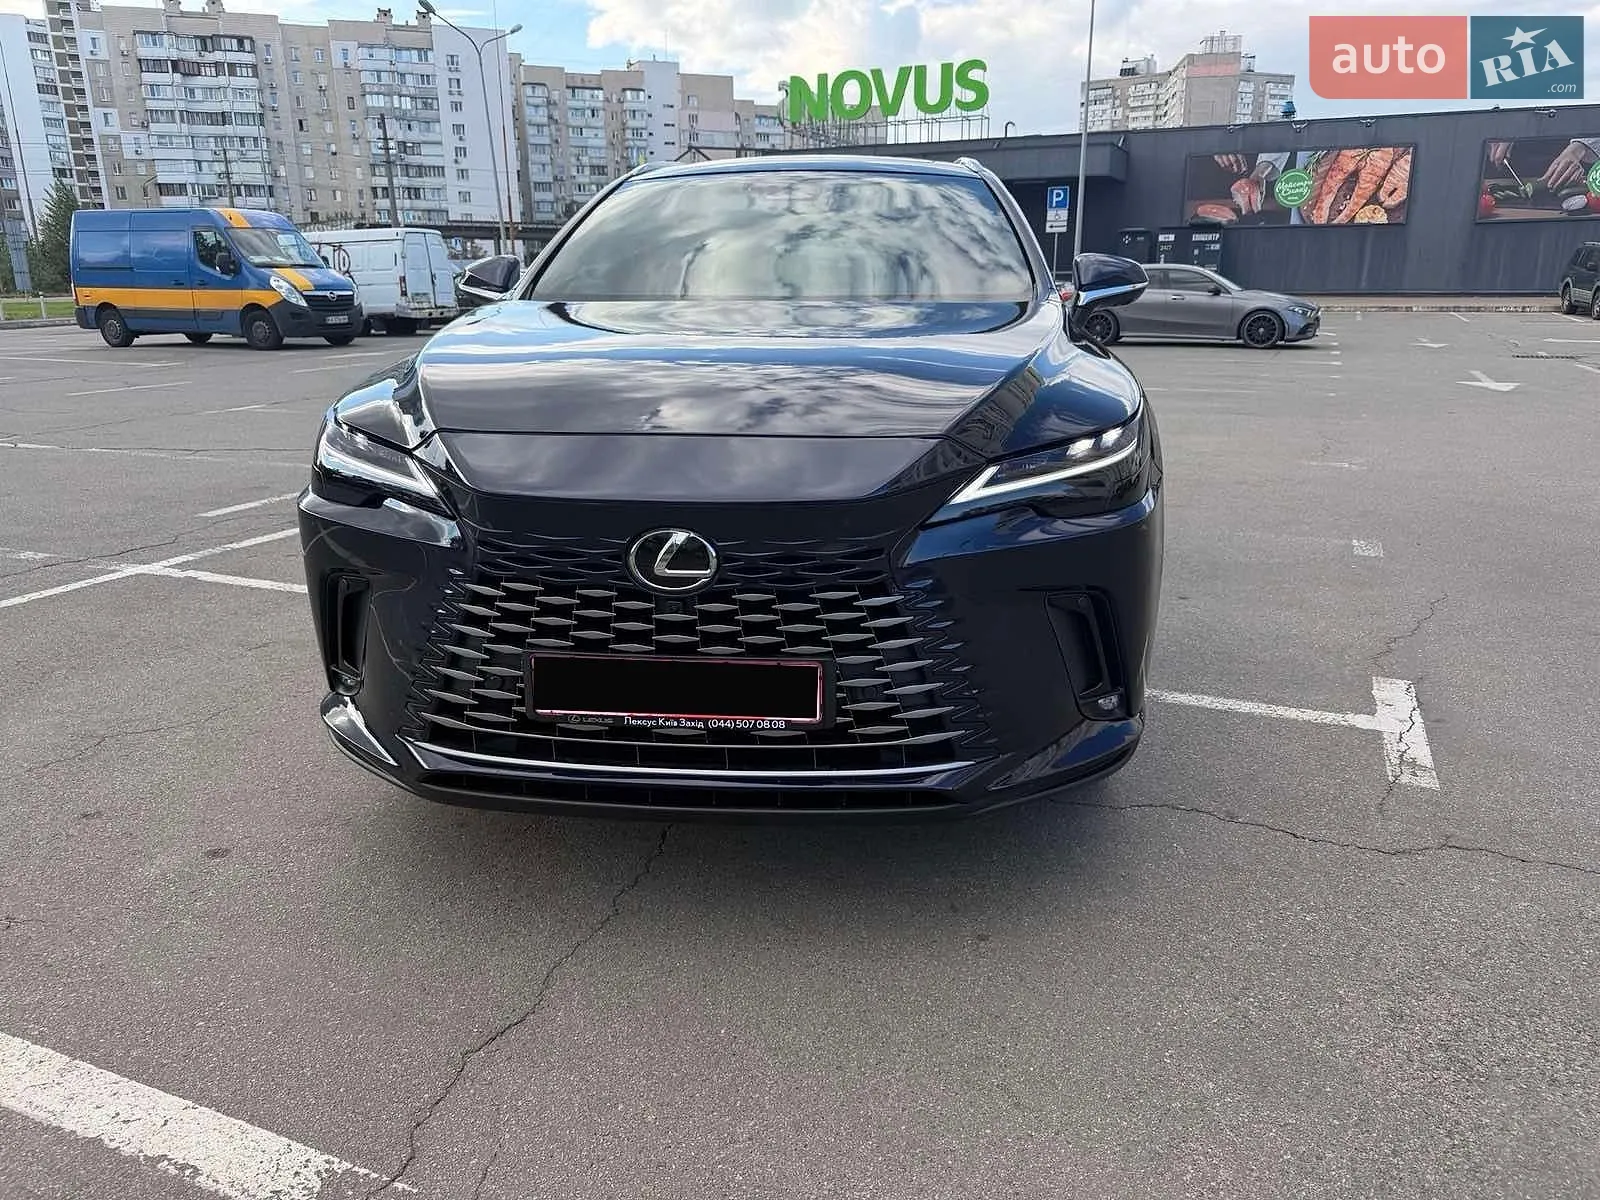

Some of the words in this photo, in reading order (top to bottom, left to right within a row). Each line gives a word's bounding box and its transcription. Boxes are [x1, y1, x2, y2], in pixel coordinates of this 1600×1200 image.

[789, 59, 990, 124] NOVUS
[1052, 189, 1064, 208] P
[658, 717, 678, 726] Київ
[679, 718, 704, 728] Захід
[708, 719, 734, 729] (044)
[735, 719, 755, 729] 507
[756, 720, 770, 729] 08
[771, 720, 786, 729] 08
